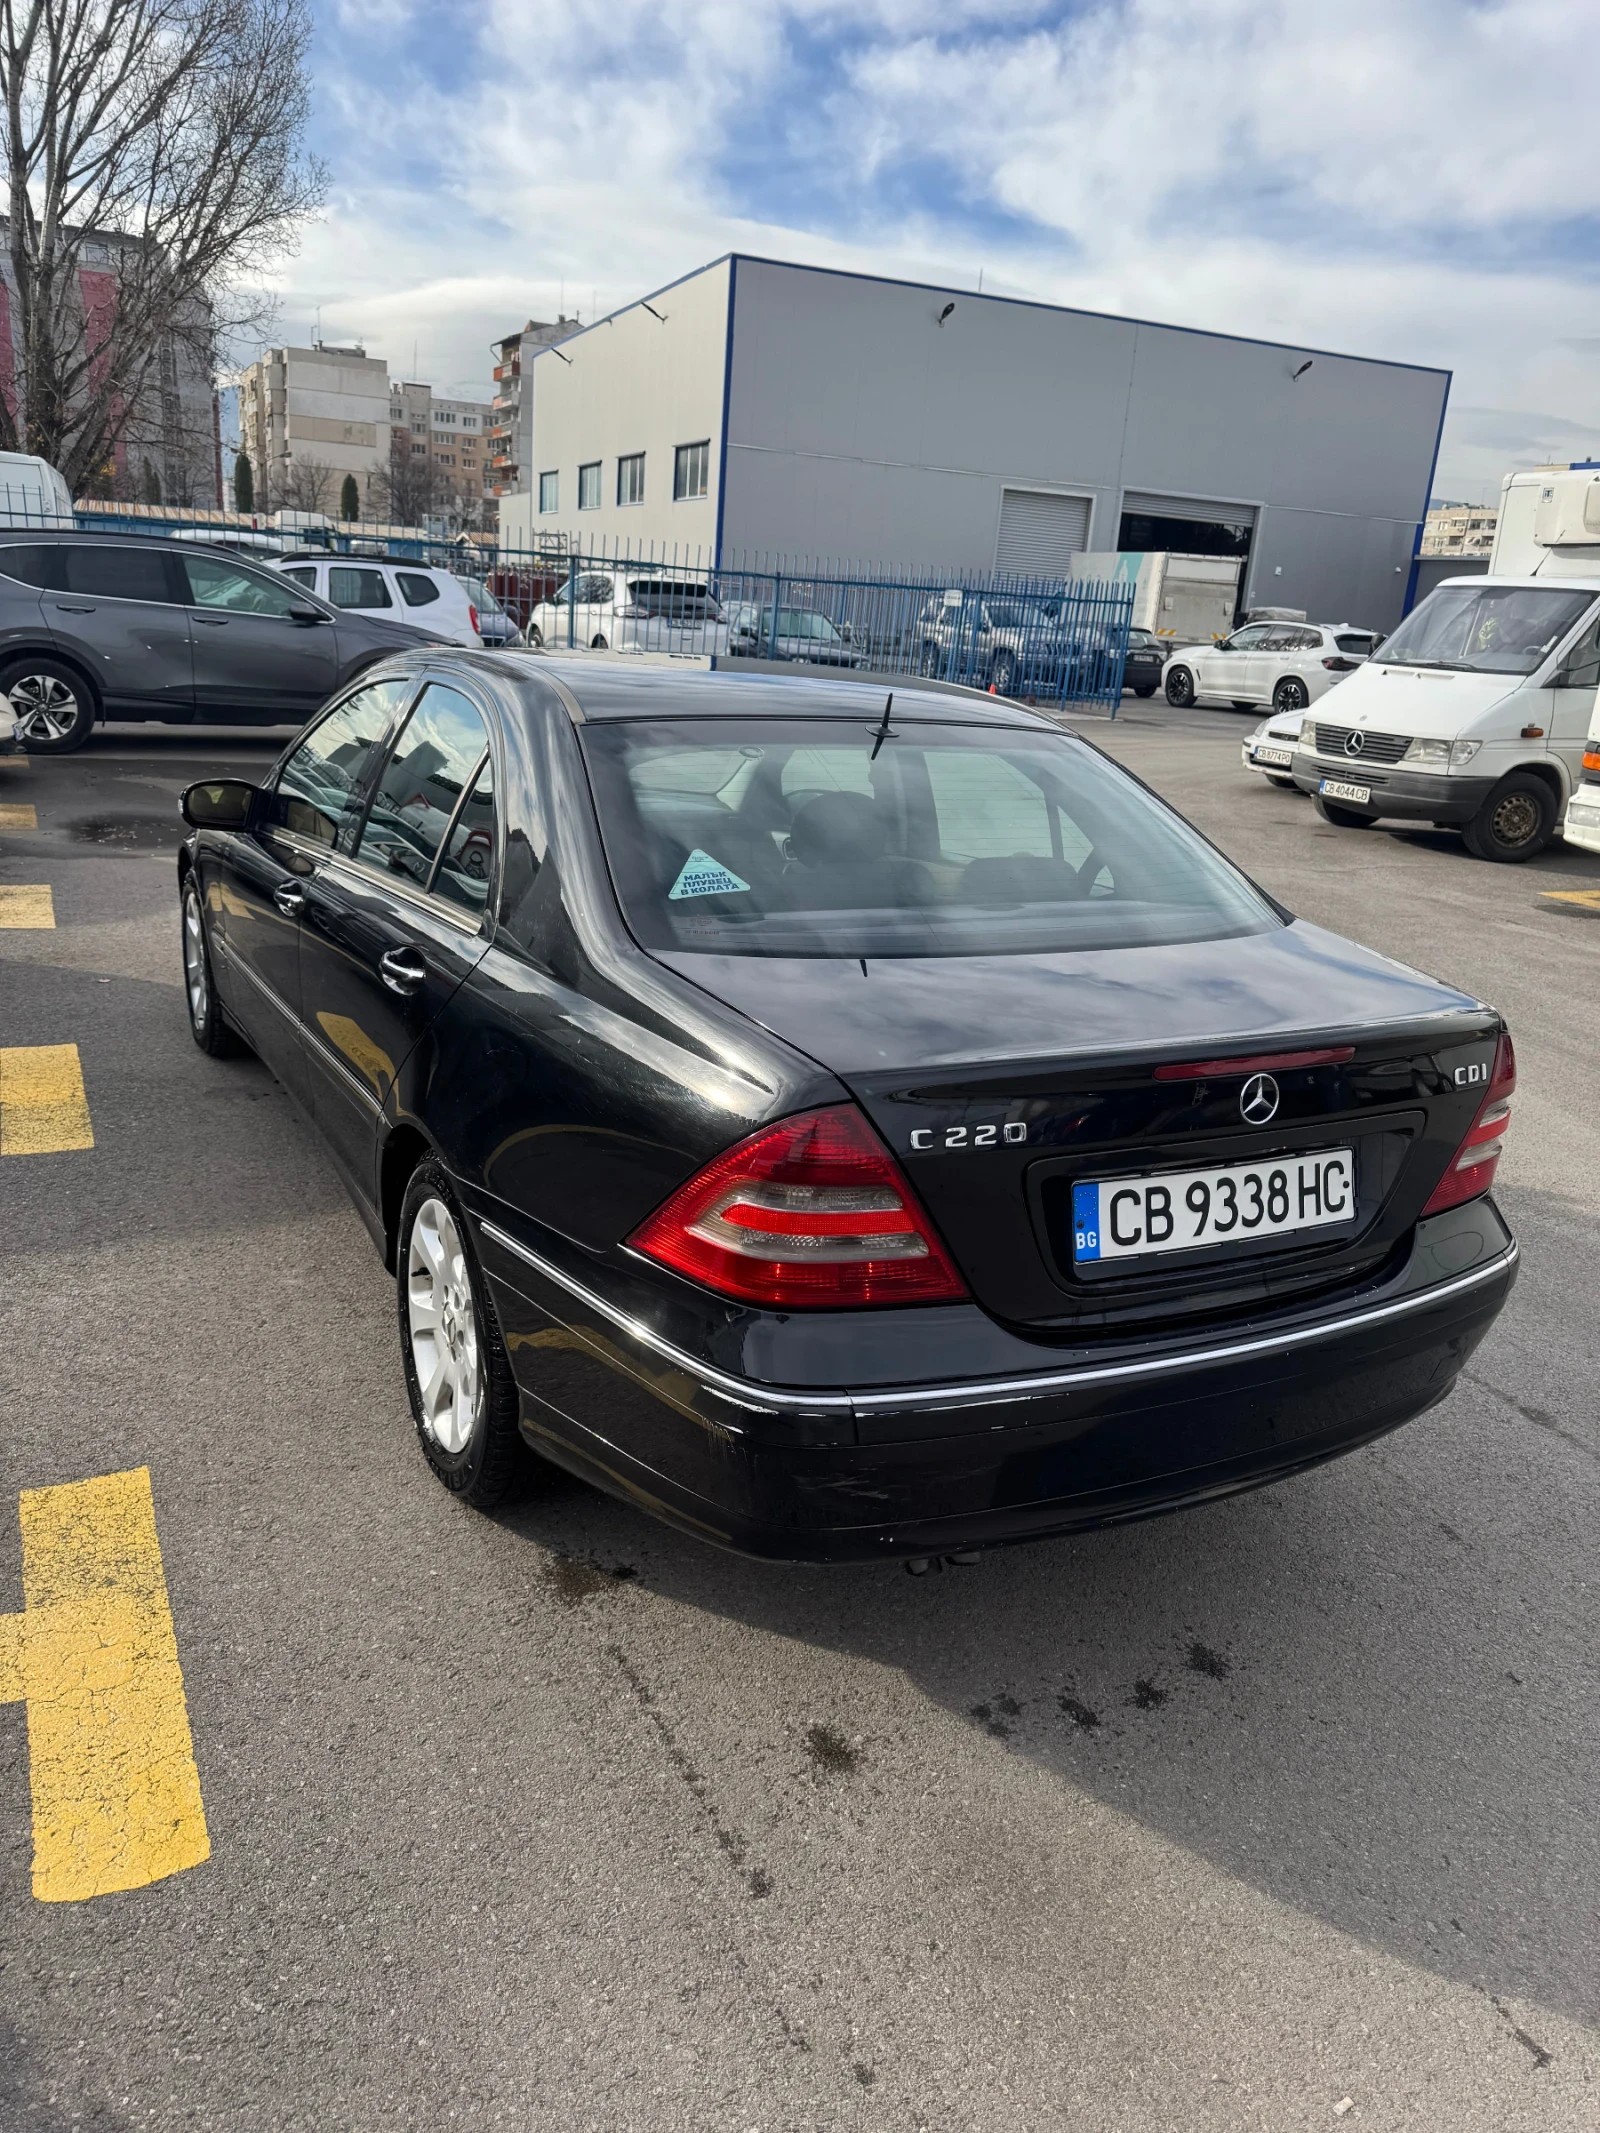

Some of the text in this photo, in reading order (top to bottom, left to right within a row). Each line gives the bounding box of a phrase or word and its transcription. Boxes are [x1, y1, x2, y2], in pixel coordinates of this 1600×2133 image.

[1335, 784, 1355, 799] 4044
[683, 877, 733, 889] ПЛУВЕЦ
[684, 871, 727, 882] МАЛЪК
[691, 883, 740, 894] КОЛАТА
[1454, 1063, 1487, 1085] CDI
[1109, 1160, 1346, 1246] CB 9338 HC
[1075, 1231, 1097, 1249] BG
